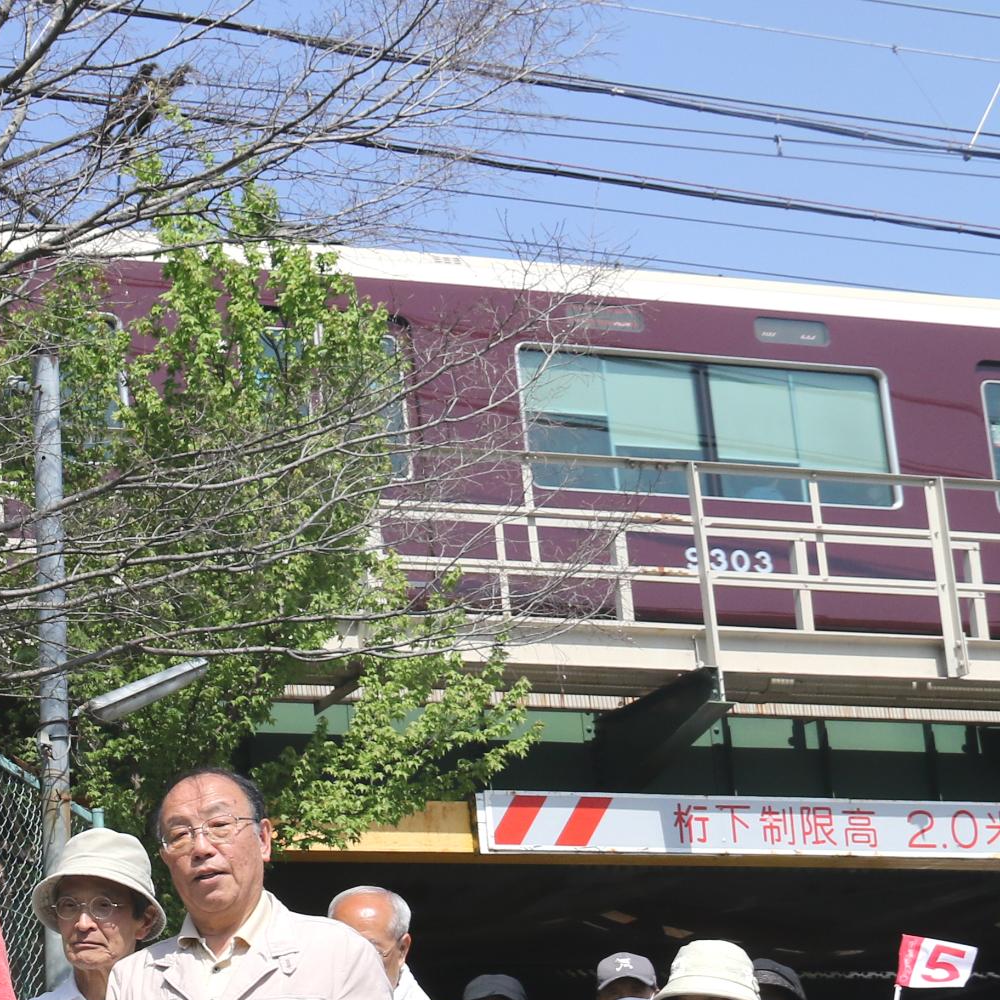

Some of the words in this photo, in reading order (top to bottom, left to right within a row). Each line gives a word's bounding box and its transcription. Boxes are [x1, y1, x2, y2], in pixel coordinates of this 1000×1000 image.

[673, 803, 879, 848] 桁下制限高
[921, 943, 967, 983] 5
